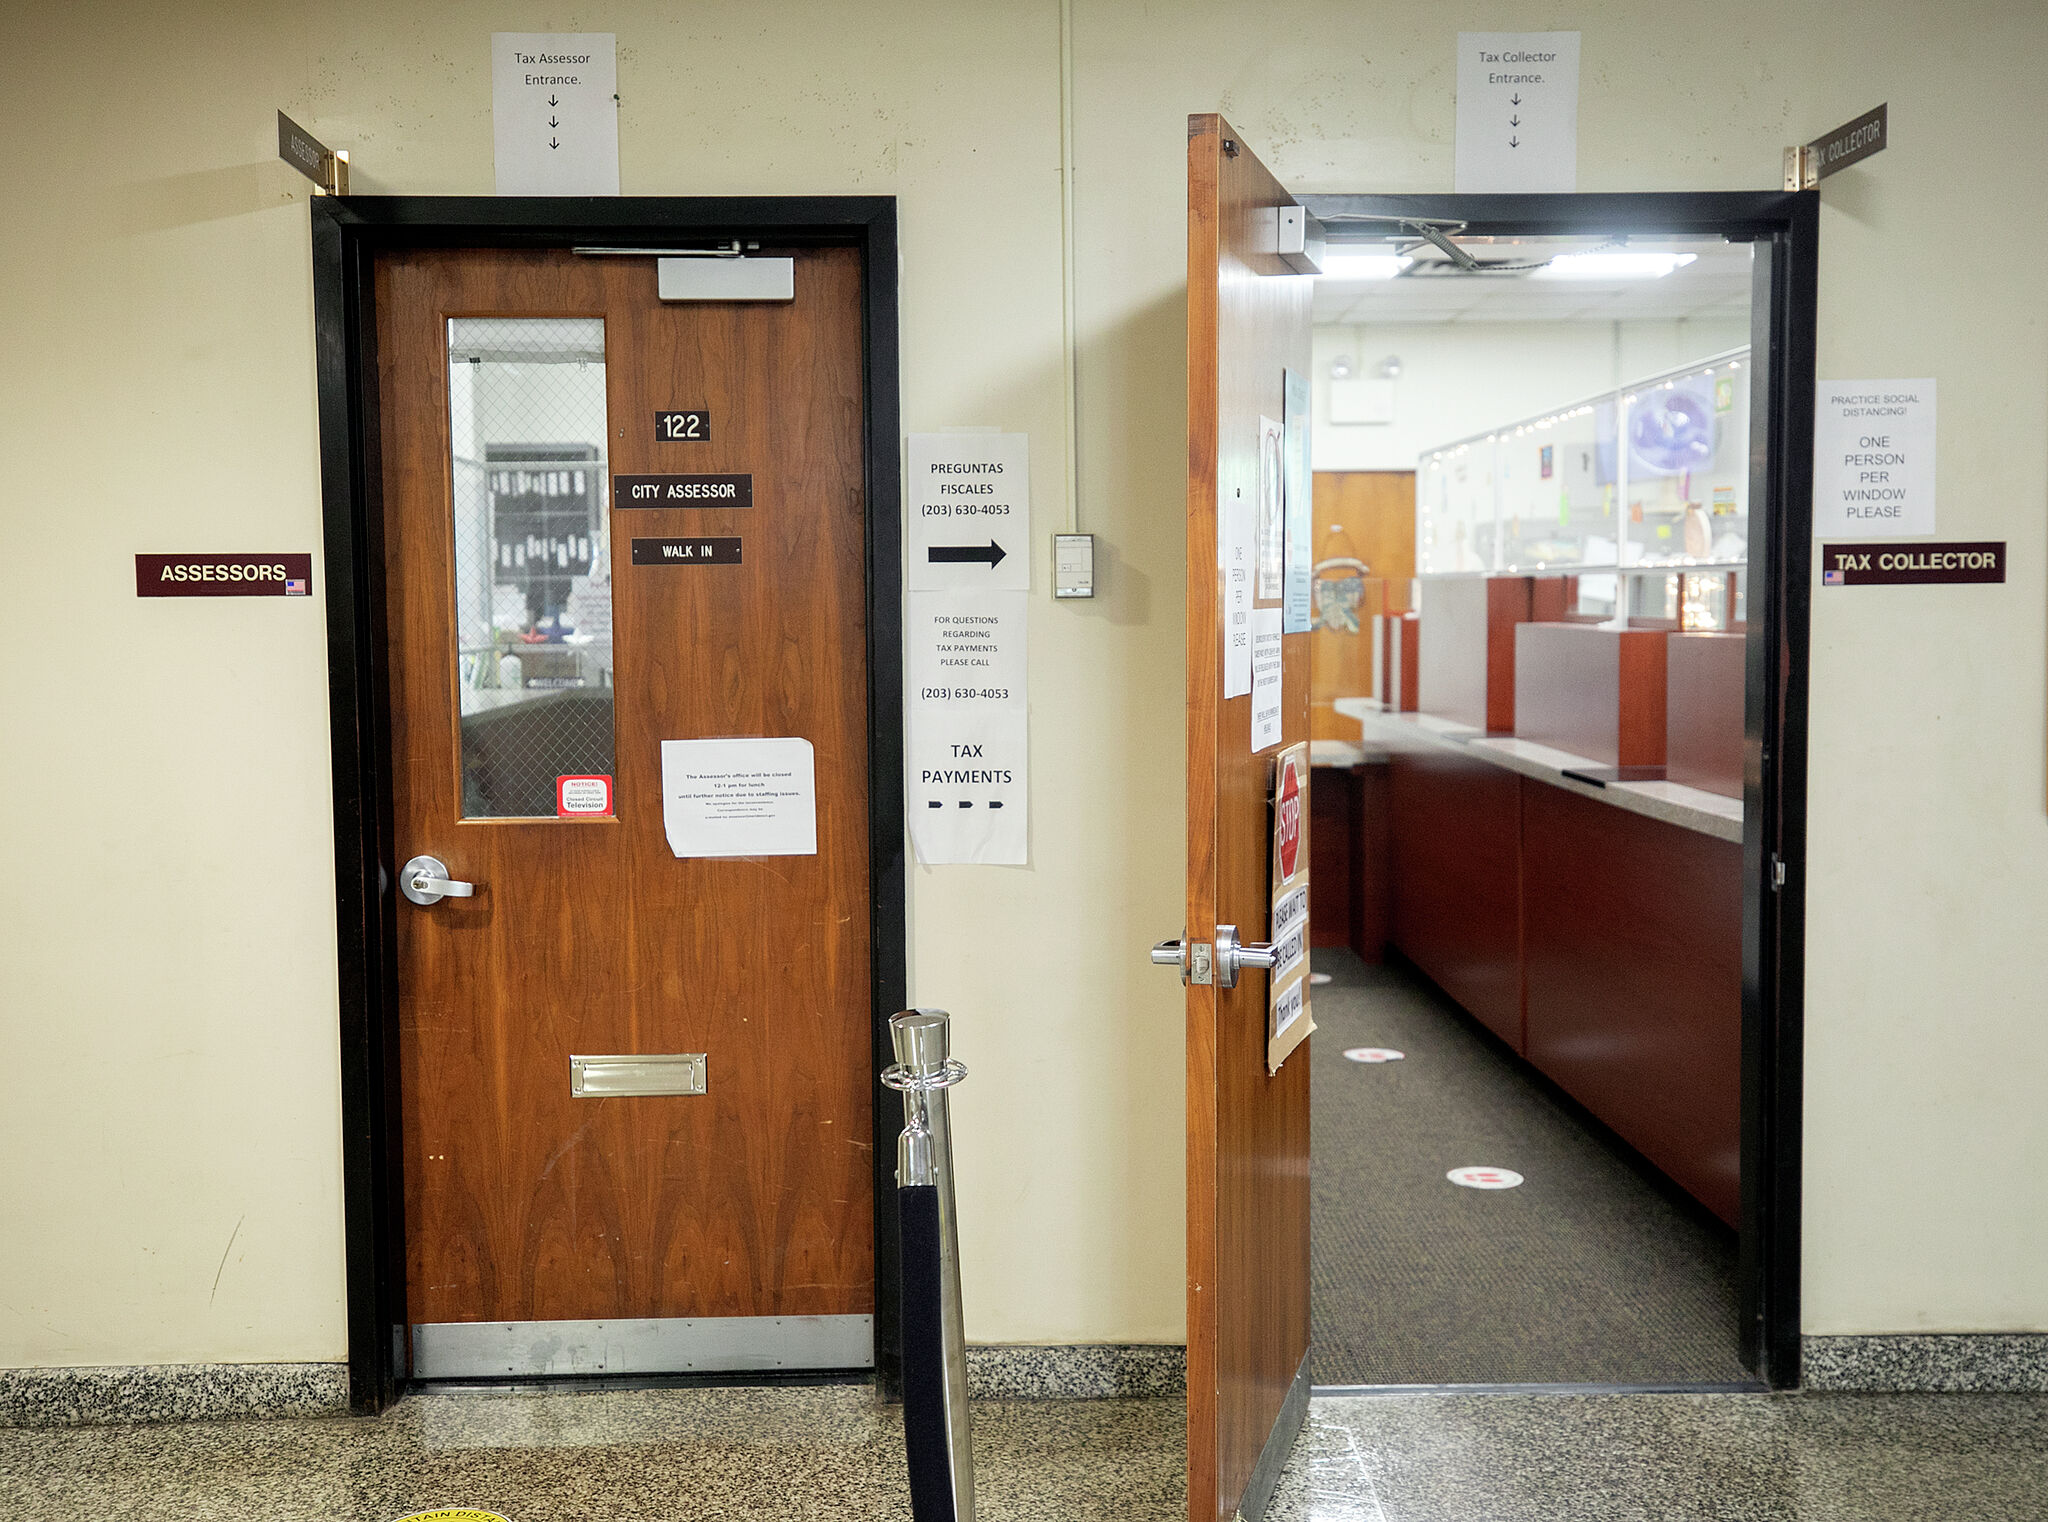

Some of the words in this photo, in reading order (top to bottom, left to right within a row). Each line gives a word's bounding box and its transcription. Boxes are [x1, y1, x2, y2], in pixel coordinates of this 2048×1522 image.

[514, 53, 536, 63] Tax
[539, 53, 590, 63] Assessor
[1479, 52, 1499, 62] Tax
[1503, 51, 1556, 63] Collector
[525, 75, 581, 85] Entrance.
[1489, 73, 1545, 84] Entrance.
[1828, 120, 1880, 162] COLLECTOR
[290, 133, 320, 171] ASSESSOR
[1831, 395, 1880, 405] PRACTICE
[1883, 394, 1919, 404] SOCIAL
[1843, 407, 1907, 417] DISTANCING!
[663, 414, 700, 438] 122
[1859, 436, 1890, 448] ONE
[1845, 453, 1905, 466] PERSON
[930, 463, 1003, 474] PREGUNTAS
[1860, 471, 1890, 483] PER
[631, 485, 660, 499] CITY
[667, 484, 736, 498] ASSESSOR
[940, 484, 994, 495] FISCALES
[1843, 488, 1906, 501] WINDOW
[921, 504, 952, 517] (203)
[955, 504, 1010, 515] 630-4053
[1846, 505, 1902, 518] PLEASE
[662, 545, 693, 558] WALK
[701, 545, 713, 557] IN
[1834, 553, 1872, 571] TAX
[1878, 552, 1996, 571] COLLECTOR
[160, 564, 287, 582] ASSESSORS
[934, 616, 950, 624] FOR
[952, 616, 999, 624] QUESTIONS
[921, 687, 951, 701] (203)
[954, 688, 1009, 699] 630-4053
[951, 744, 983, 758] TAX
[922, 770, 1012, 784] PAYMENTS
[1281, 796, 1299, 846] STOP
